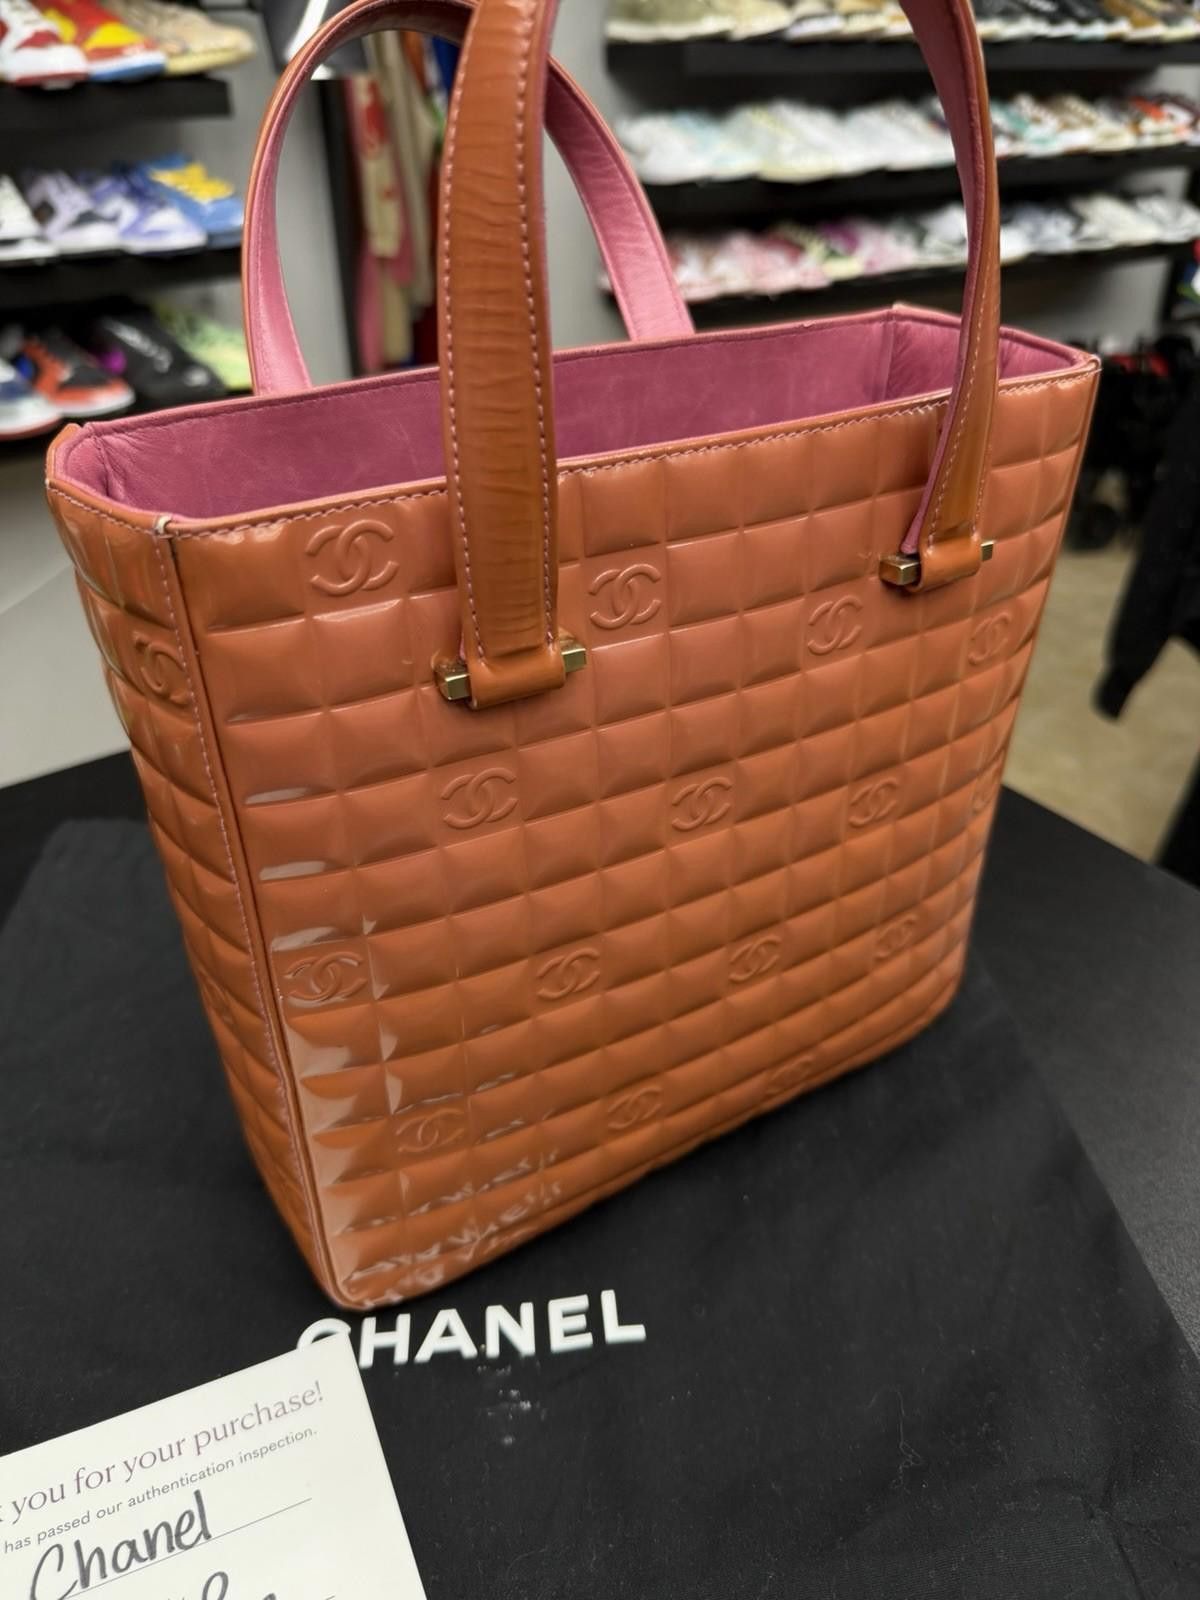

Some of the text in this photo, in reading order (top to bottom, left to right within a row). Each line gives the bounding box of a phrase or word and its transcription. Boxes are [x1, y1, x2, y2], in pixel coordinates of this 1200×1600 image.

[4, 1536, 31, 1554] has
[37, 1510, 91, 1545] passed
[96, 1502, 122, 1519] our
[128, 1457, 235, 1508] authentication
[239, 1427, 317, 1464] inspection.
[12, 1483, 66, 1525] you
[74, 1466, 116, 1494] for
[123, 1437, 187, 1483] your
[193, 1380, 324, 1456] purchase!
[30, 1488, 213, 1600] Chanel
